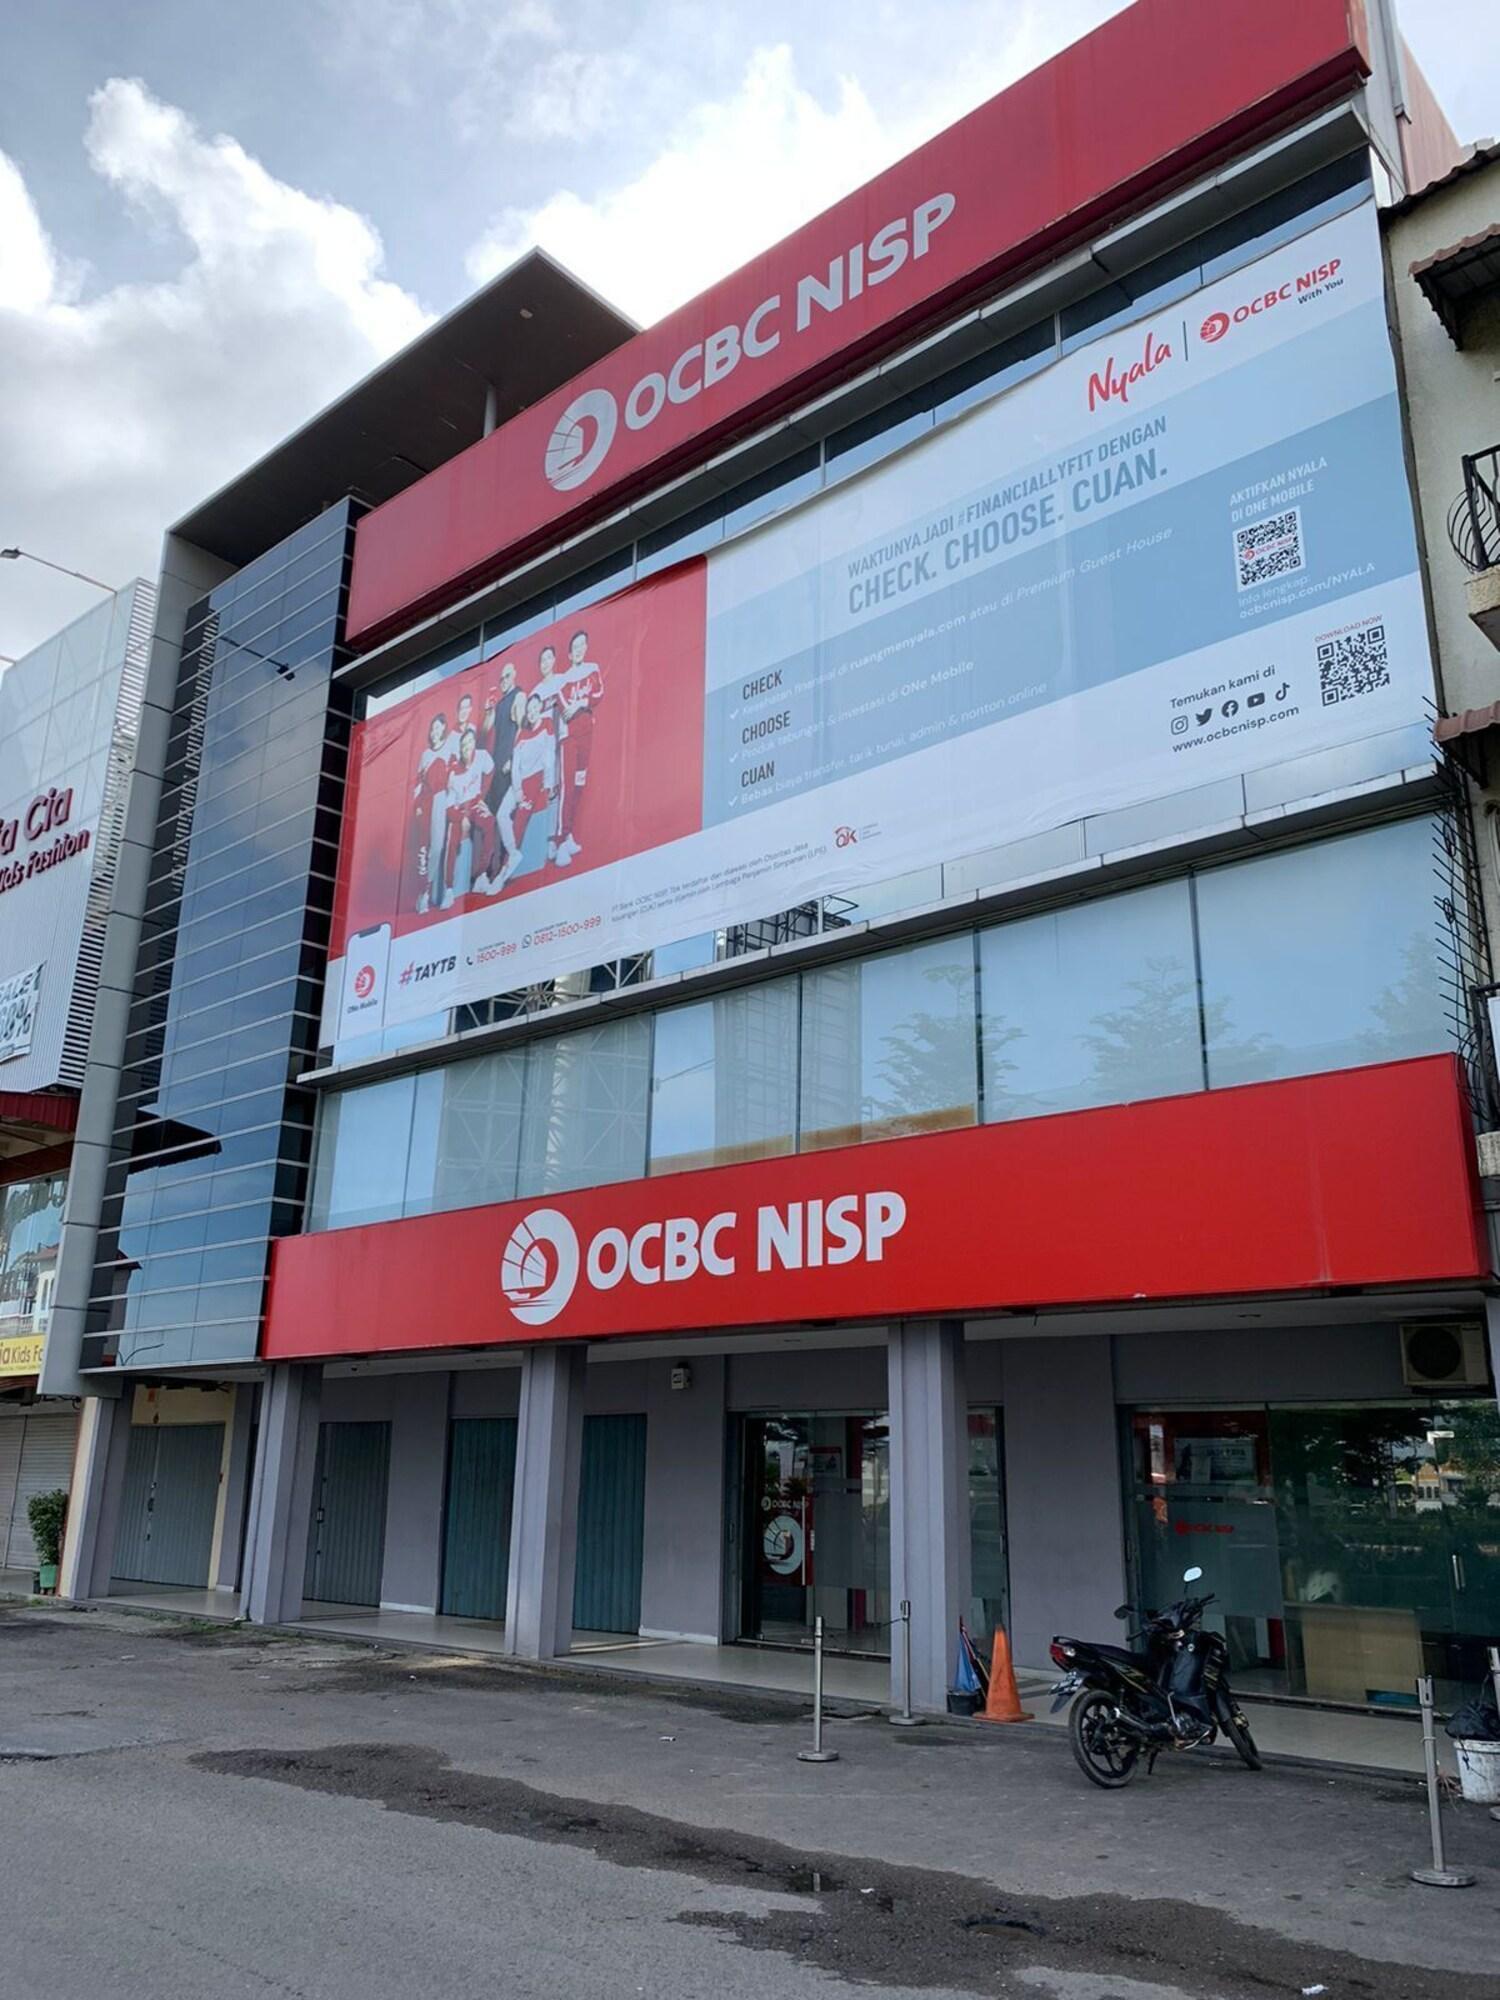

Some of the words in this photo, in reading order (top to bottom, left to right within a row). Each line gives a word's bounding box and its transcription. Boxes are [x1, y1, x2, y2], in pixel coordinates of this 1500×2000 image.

[625, 295, 780, 431] OCBC
[796, 193, 956, 332] NISP
[1233, 283, 1291, 324] OCBC
[1296, 258, 1341, 292] NISP
[1298, 289, 1323, 305] With
[1325, 278, 1344, 292] You
[1088, 332, 1172, 412] Nyala
[1288, 456, 1328, 481] NYALA
[848, 535, 921, 578] WAKTUNYA
[923, 515, 954, 544] JADI
[958, 449, 1093, 527] #FINANCIALLYFIT
[1099, 415, 1167, 461] DENGAN
[1271, 479, 1315, 505] MOBILE
[849, 551, 937, 614] CHECK.
[945, 494, 1064, 570] CHOOSE.
[1073, 447, 1167, 513] CUAN.
[1016, 568, 1075, 601] Premium
[1079, 547, 1121, 574] Guest
[1125, 527, 1173, 554] House
[1314, 624, 1361, 642] DOWNLOAD
[1362, 614, 1383, 627] NOW
[742, 669, 783, 700] CHECK
[930, 661, 975, 685] Mobile
[1008, 682, 1048, 705] online
[1170, 685, 1226, 709] Temukan
[1228, 669, 1260, 690] kami
[1263, 664, 1276, 678] di
[741, 710, 791, 744] CHOOSE
[1172, 705, 1300, 752] www.ocbcnisp.com
[741, 761, 775, 788] CUAN
[24, 787, 73, 841] Cia
[26, 829, 90, 879] Fashion
[399, 955, 457, 985] #TAYTB
[586, 1212, 737, 1290] OCBC
[757, 1191, 907, 1273] NISP
